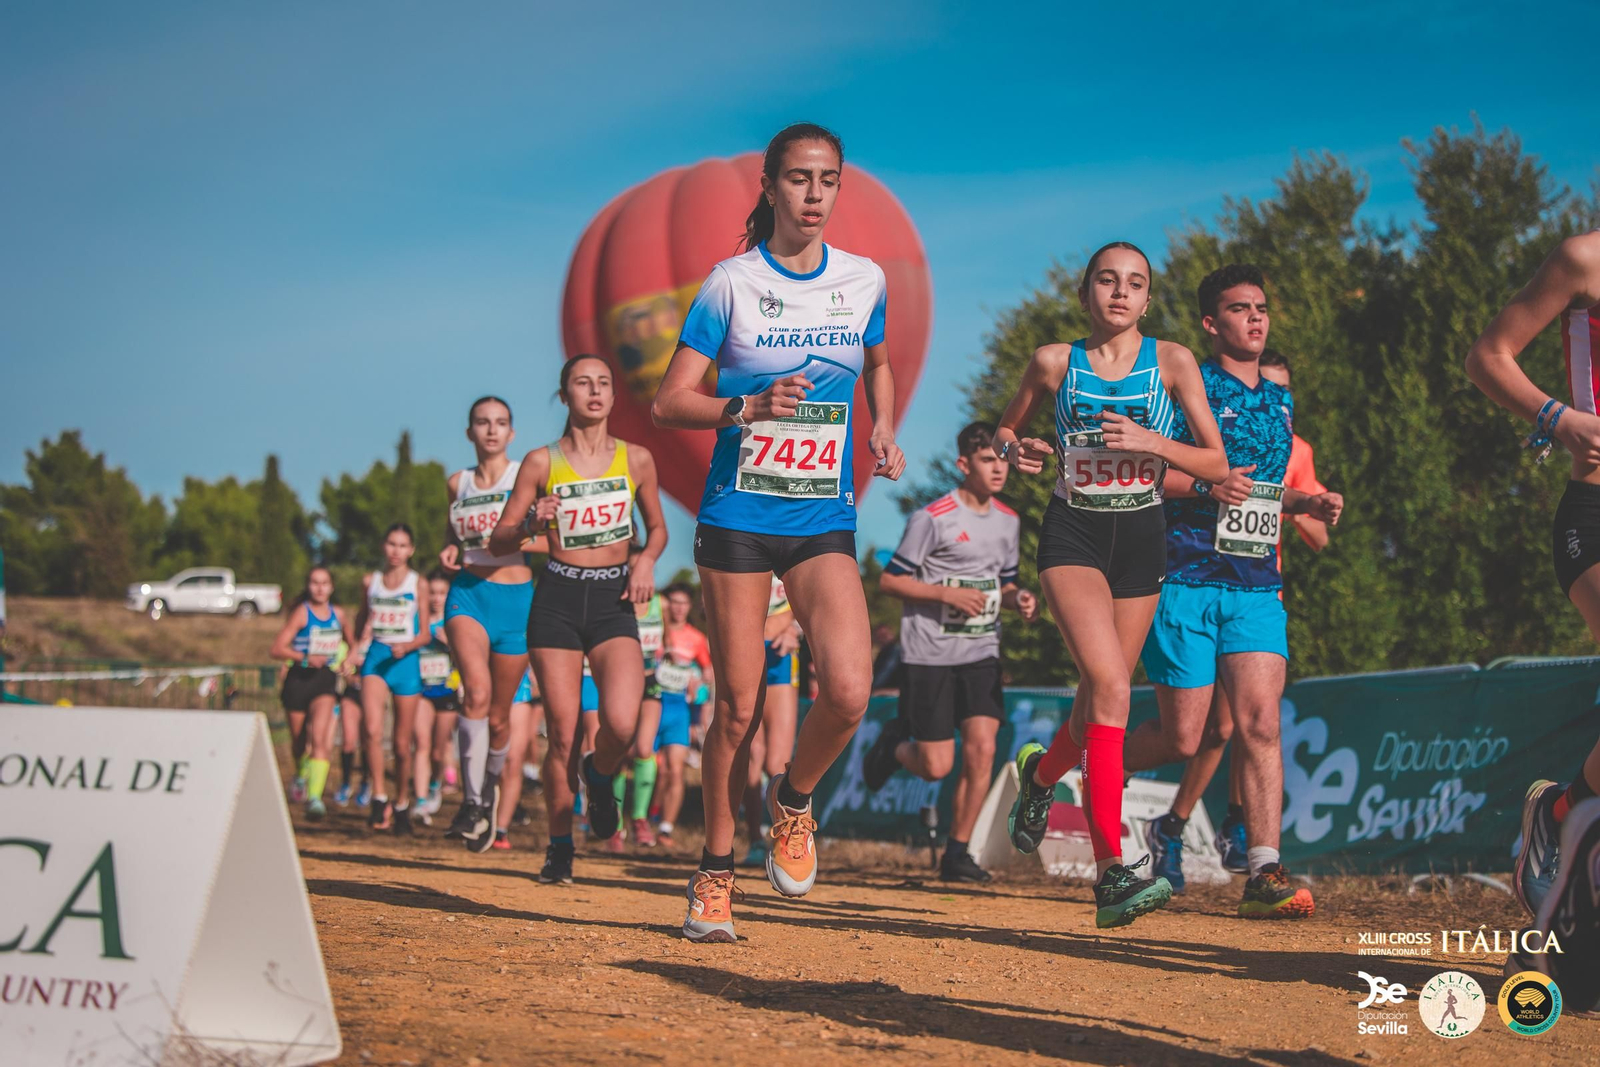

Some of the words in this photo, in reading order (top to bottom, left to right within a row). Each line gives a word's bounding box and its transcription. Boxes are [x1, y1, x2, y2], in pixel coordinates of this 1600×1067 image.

[756, 332, 860, 348] MARACENA
[753, 435, 837, 470] 7424
[1075, 458, 1155, 487] 5506
[456, 511, 499, 536] 7488
[564, 502, 626, 531] 7457
[1226, 508, 1278, 537] 8089
[580, 567, 621, 580] PRO
[1373, 726, 1509, 781] Diputación
[128, 760, 189, 793] DE
